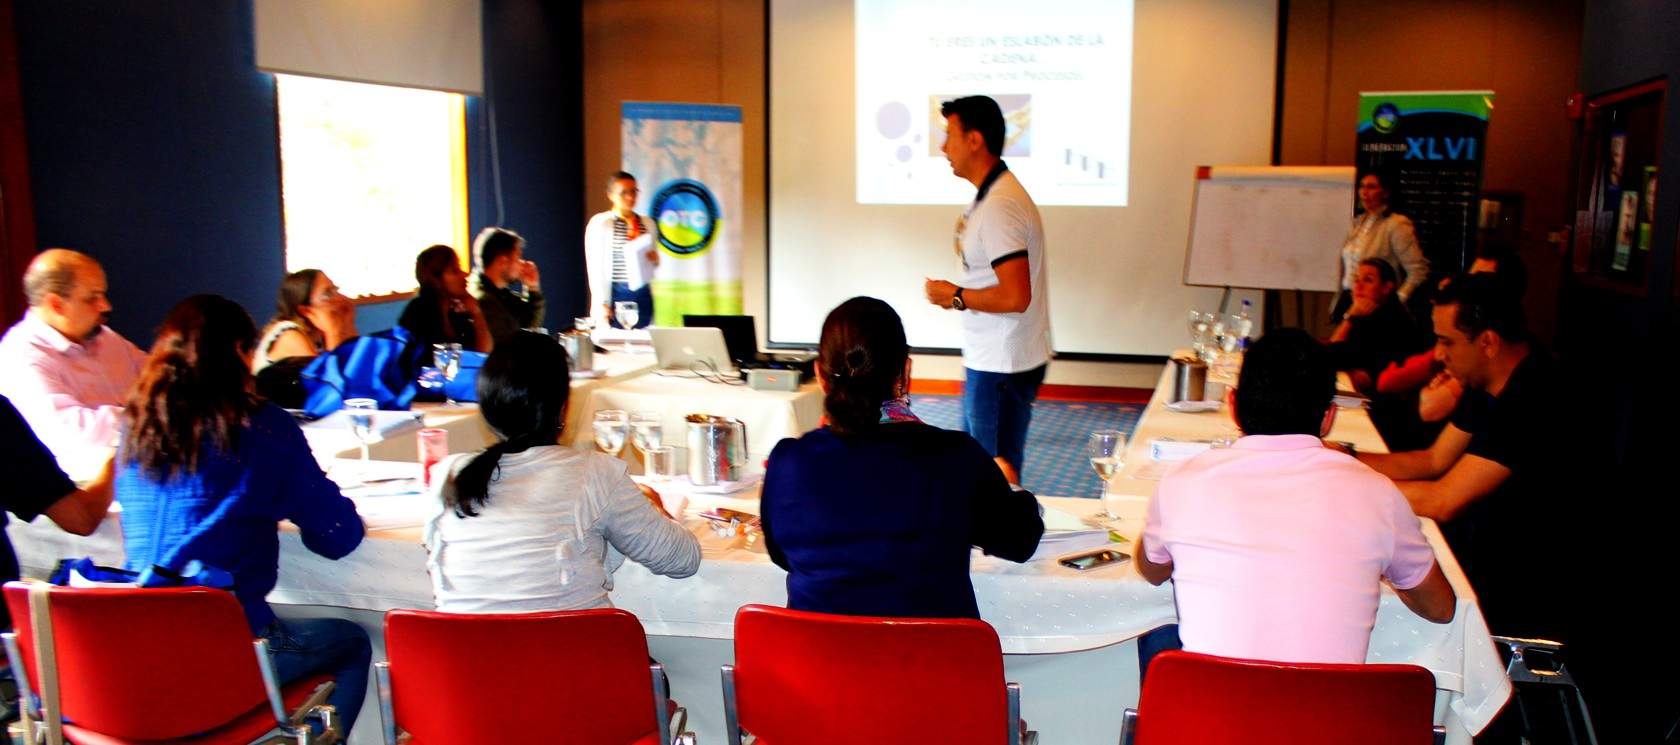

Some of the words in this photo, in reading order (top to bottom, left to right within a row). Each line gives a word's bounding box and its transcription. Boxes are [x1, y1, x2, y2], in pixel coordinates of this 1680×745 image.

[1067, 33, 1085, 46] DE
[1088, 33, 1105, 46] LA
[1404, 136, 1476, 160] XLVI
[659, 209, 706, 228] OTC
